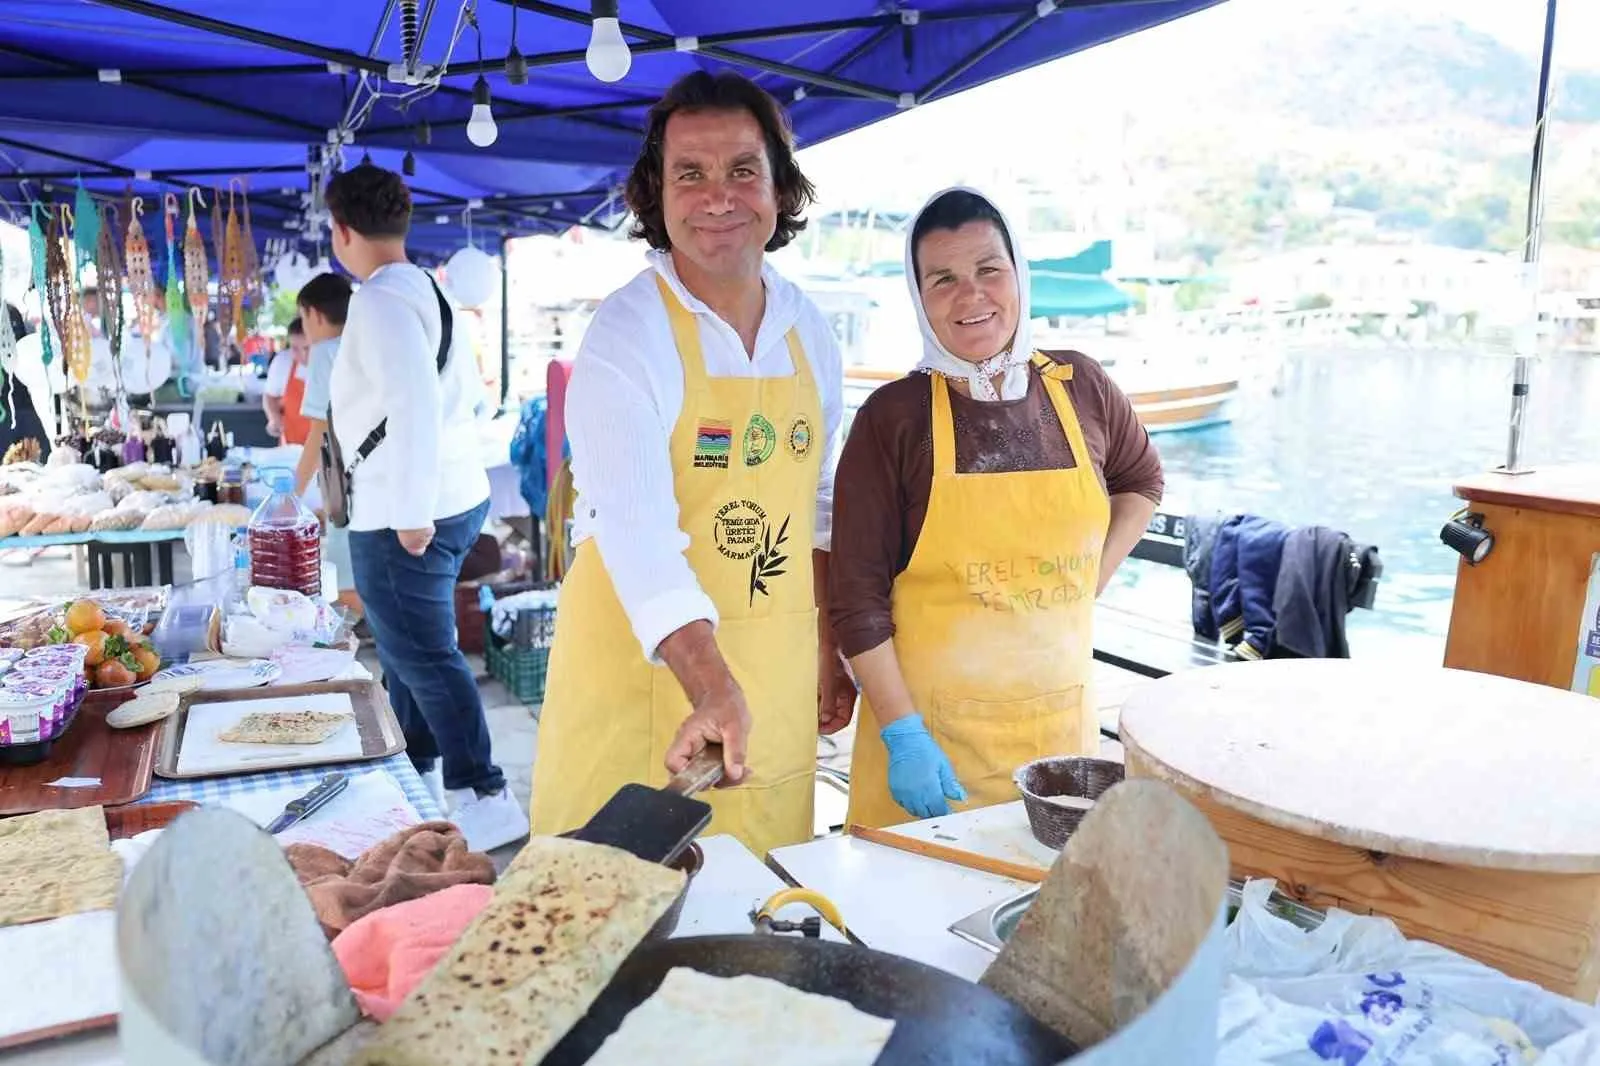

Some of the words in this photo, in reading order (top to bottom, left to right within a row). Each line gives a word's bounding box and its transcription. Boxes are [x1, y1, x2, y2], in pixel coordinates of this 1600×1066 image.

[715, 500, 740, 520] YEREL
[741, 499, 767, 520] TOHUM
[744, 518, 760, 526] GIDA
[727, 536, 755, 544] PAZARI
[943, 558, 1022, 587] YEREL
